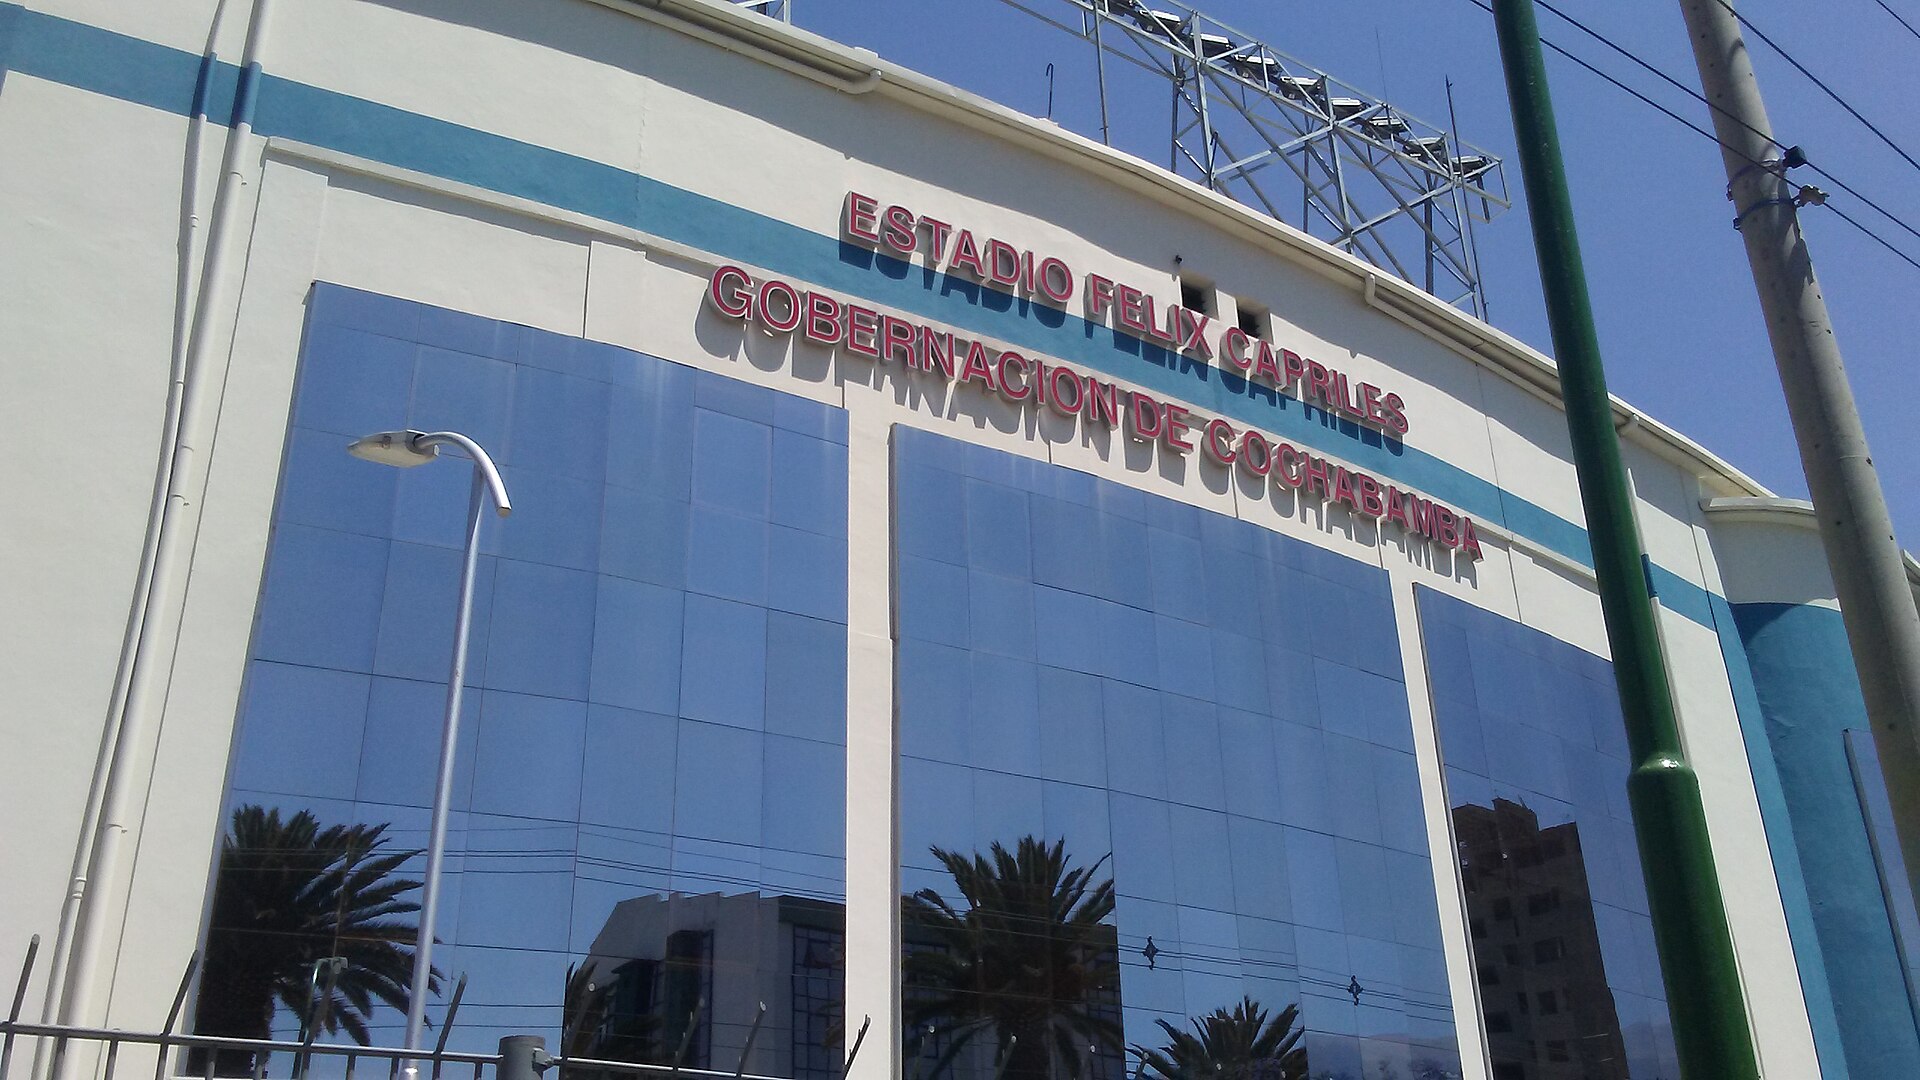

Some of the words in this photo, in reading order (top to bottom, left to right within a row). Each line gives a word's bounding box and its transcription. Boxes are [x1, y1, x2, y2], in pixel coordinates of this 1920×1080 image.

[710, 265, 1119, 431] GOBERNACION
[1131, 391, 1194, 454] DE
[1206, 419, 1484, 562] COCHABAMBA
[848, 191, 1074, 303] ESTADIO
[1088, 272, 1213, 359] FELIX
[1223, 326, 1409, 434] CAPRILES
